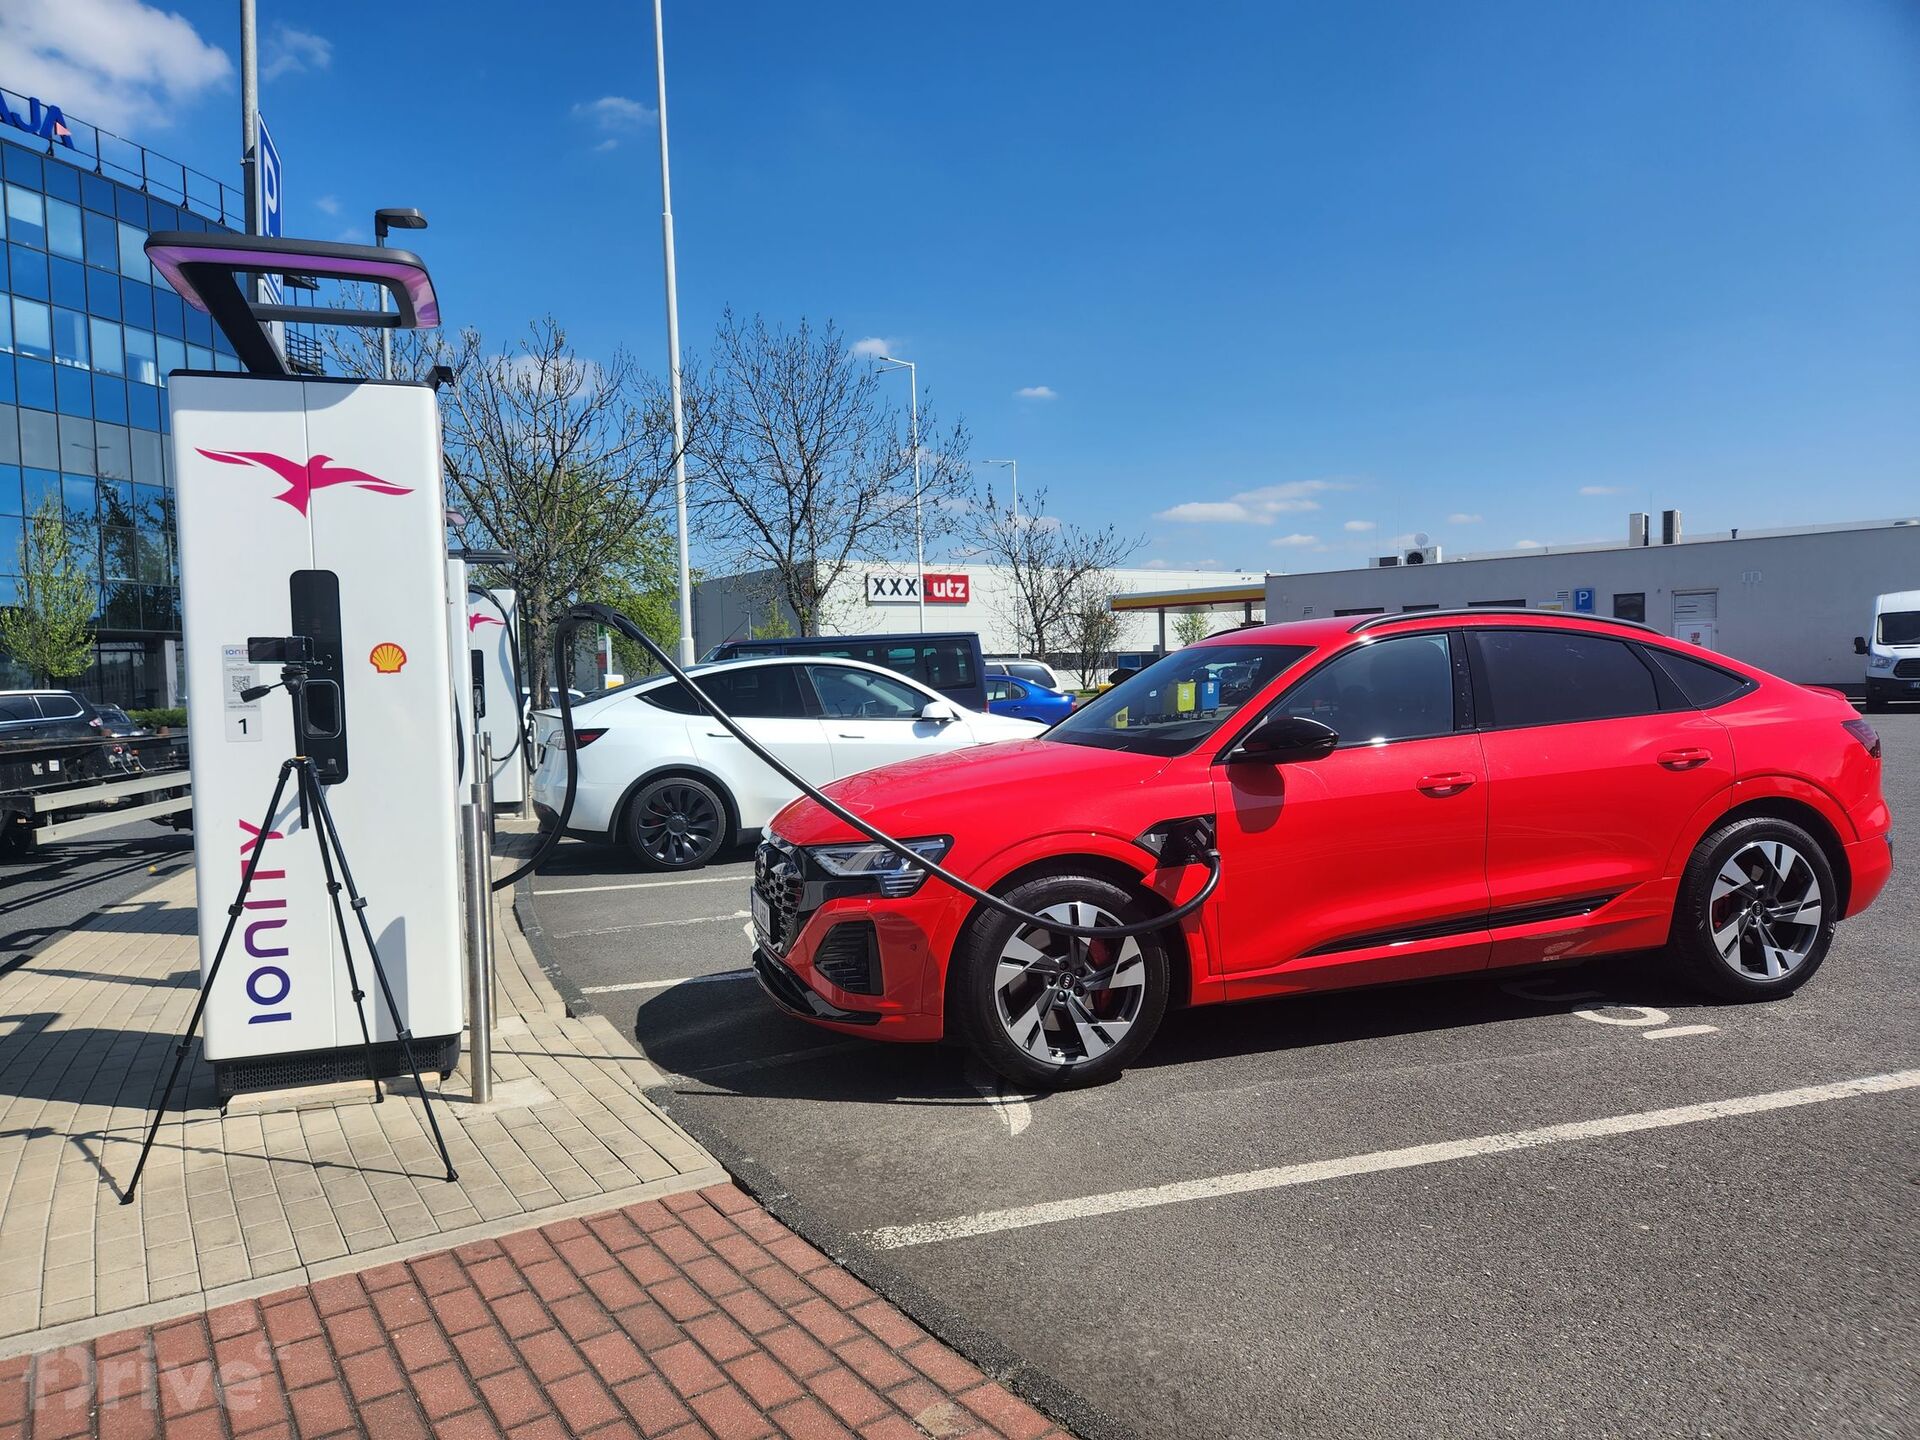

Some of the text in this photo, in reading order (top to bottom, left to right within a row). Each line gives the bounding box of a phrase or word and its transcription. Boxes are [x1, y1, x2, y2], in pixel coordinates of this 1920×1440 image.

[264, 145, 277, 236] P
[1579, 591, 1589, 605] P
[238, 718, 247, 734] 1
